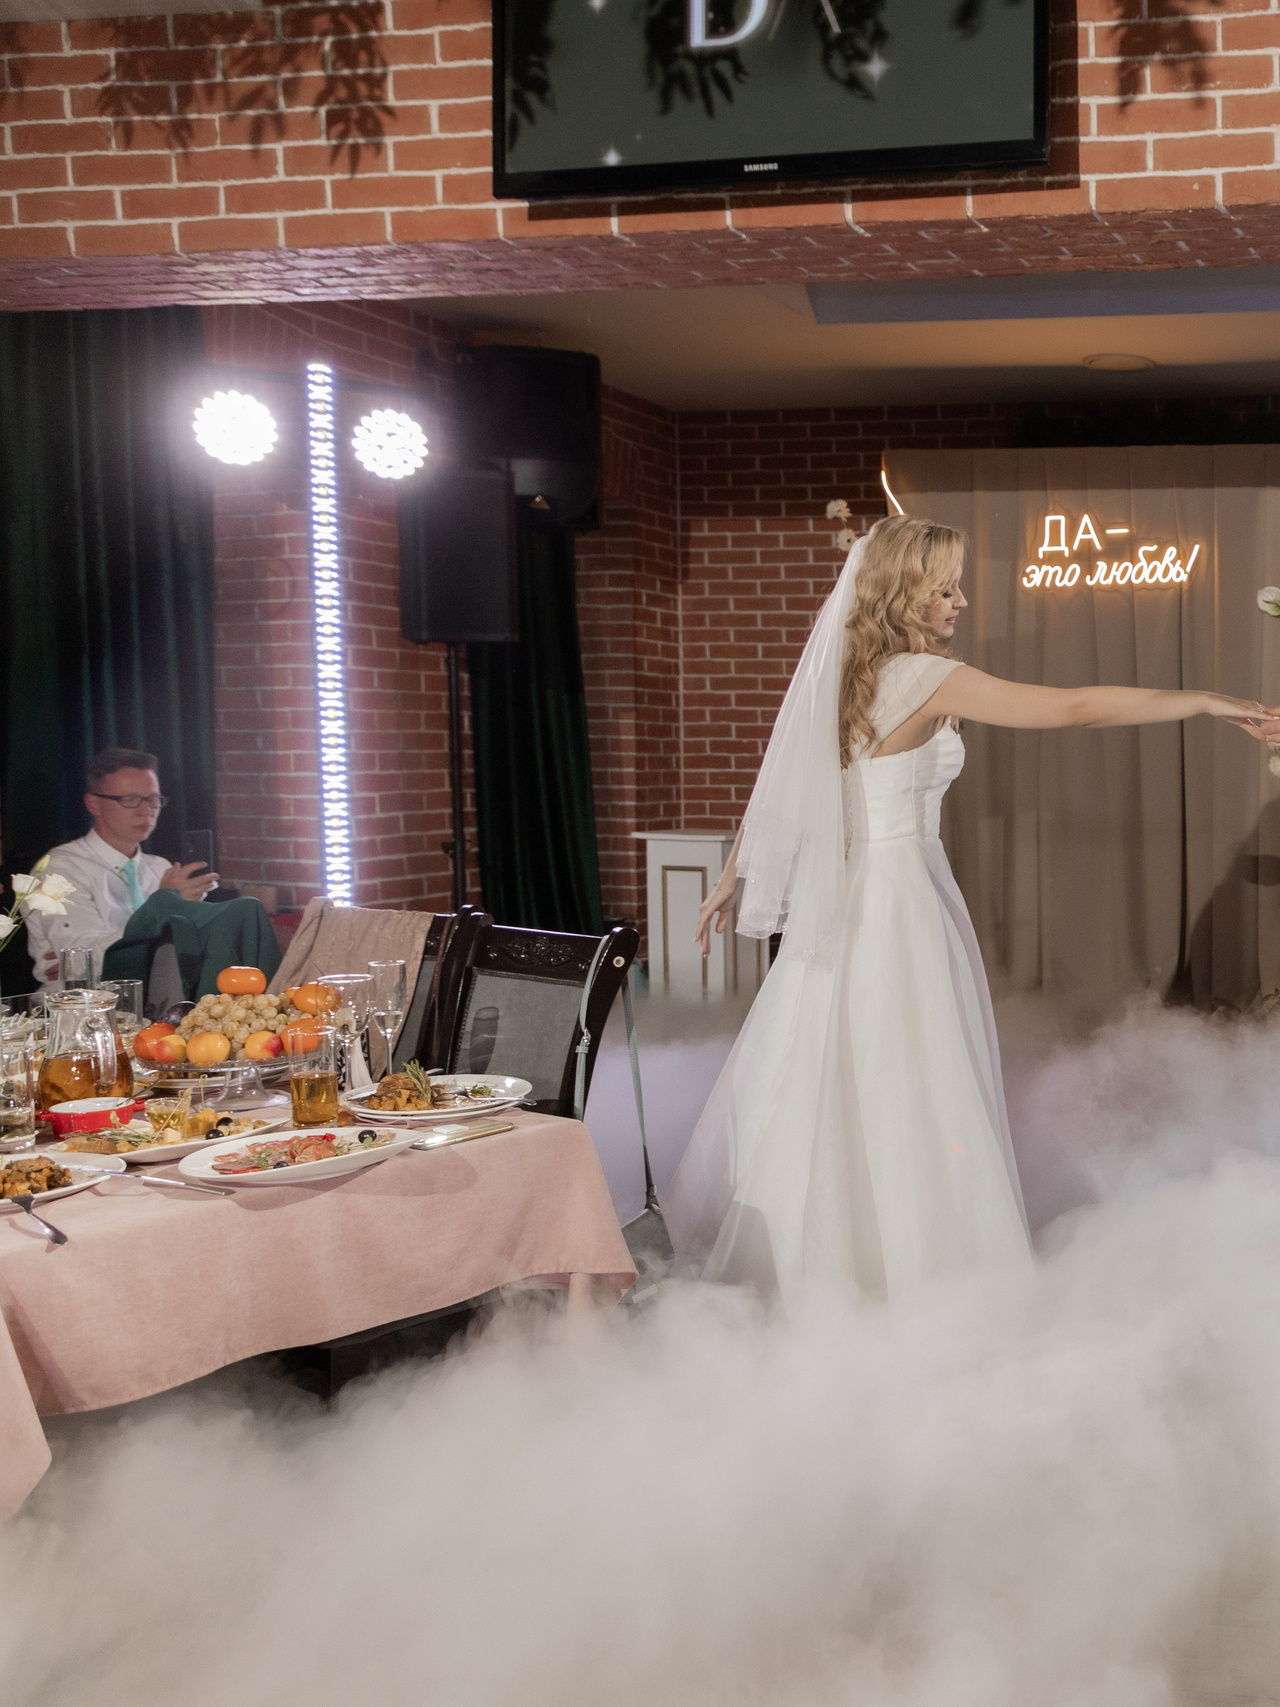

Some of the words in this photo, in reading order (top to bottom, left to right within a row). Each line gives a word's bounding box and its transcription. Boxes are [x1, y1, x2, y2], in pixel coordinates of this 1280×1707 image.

[743, 162, 779, 172] SAMSUNG
[1022, 561, 1081, 588] это
[1086, 543, 1200, 585] любовь!
